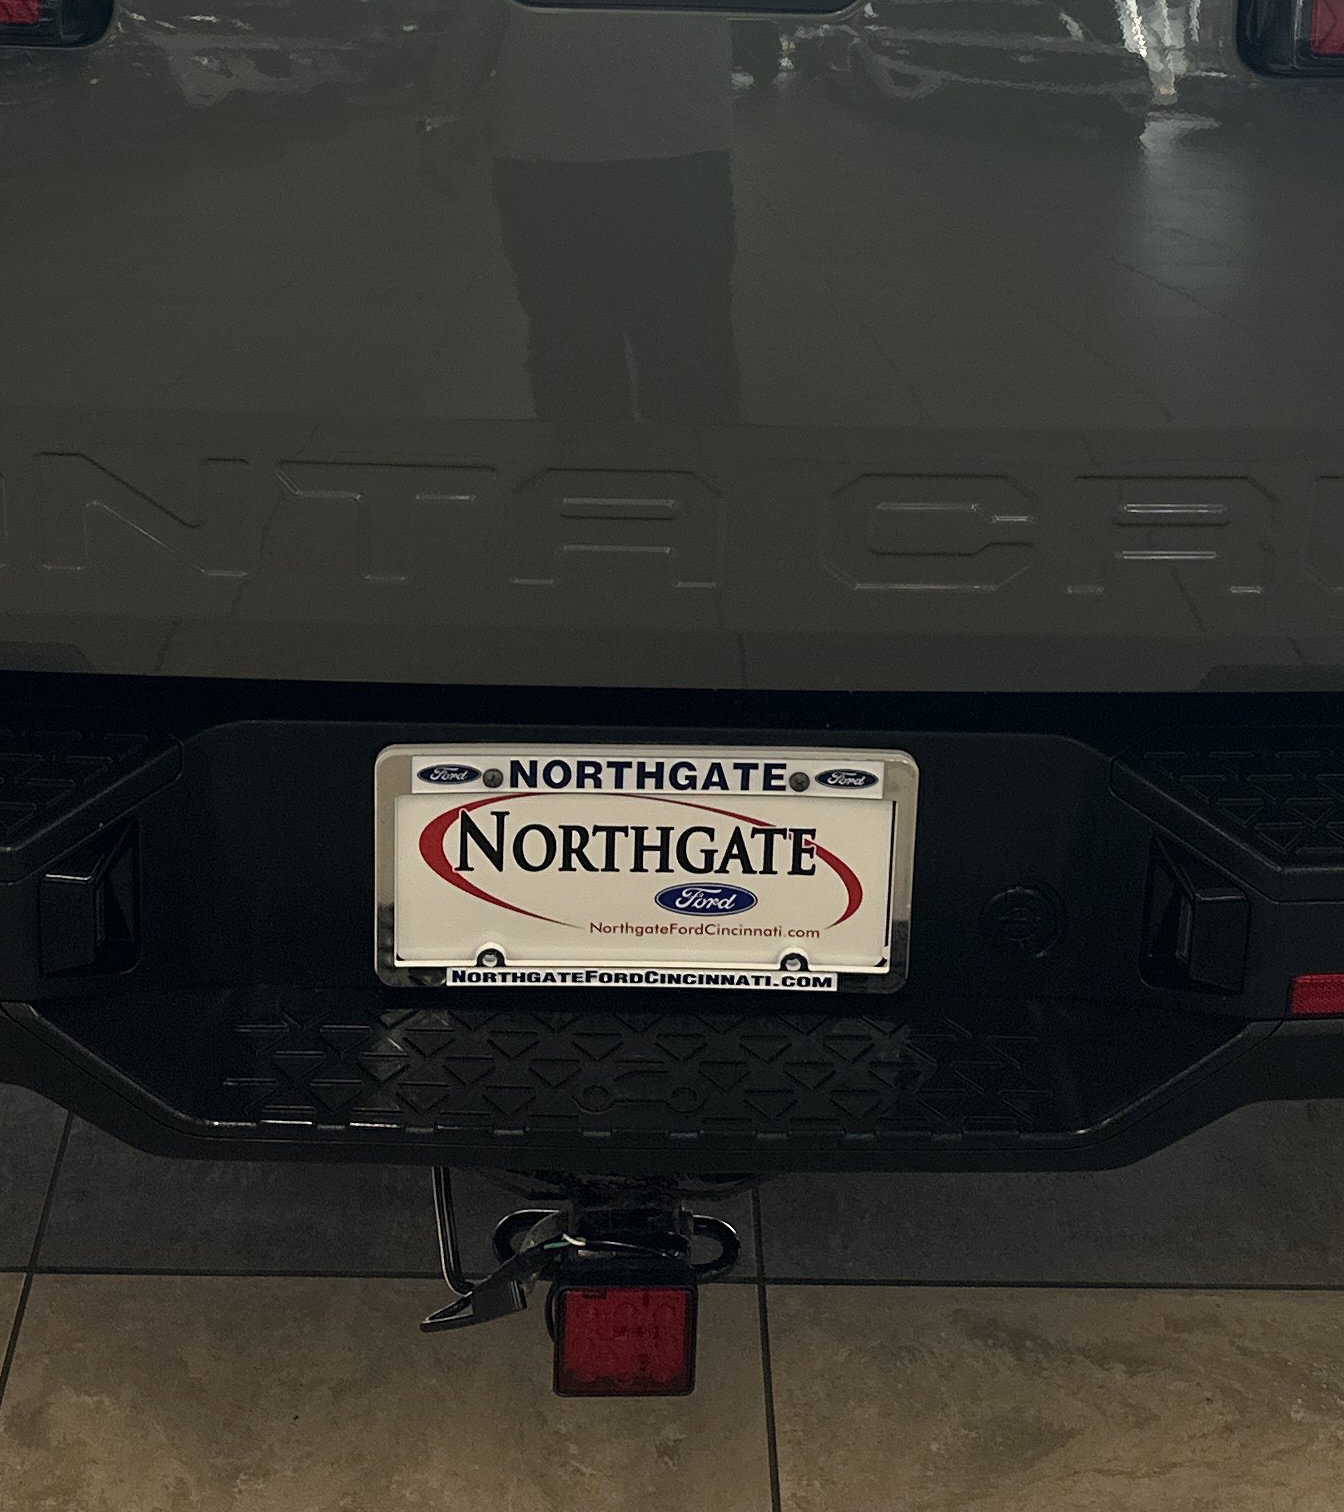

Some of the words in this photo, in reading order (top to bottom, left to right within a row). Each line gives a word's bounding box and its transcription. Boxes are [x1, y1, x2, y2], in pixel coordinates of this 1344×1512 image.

[509, 759, 787, 792] NORTHGATE
[454, 809, 817, 876] NORTHGATE
[675, 886, 736, 910] Ford
[589, 922, 820, 939] NorthgateFordCincinnati.com
